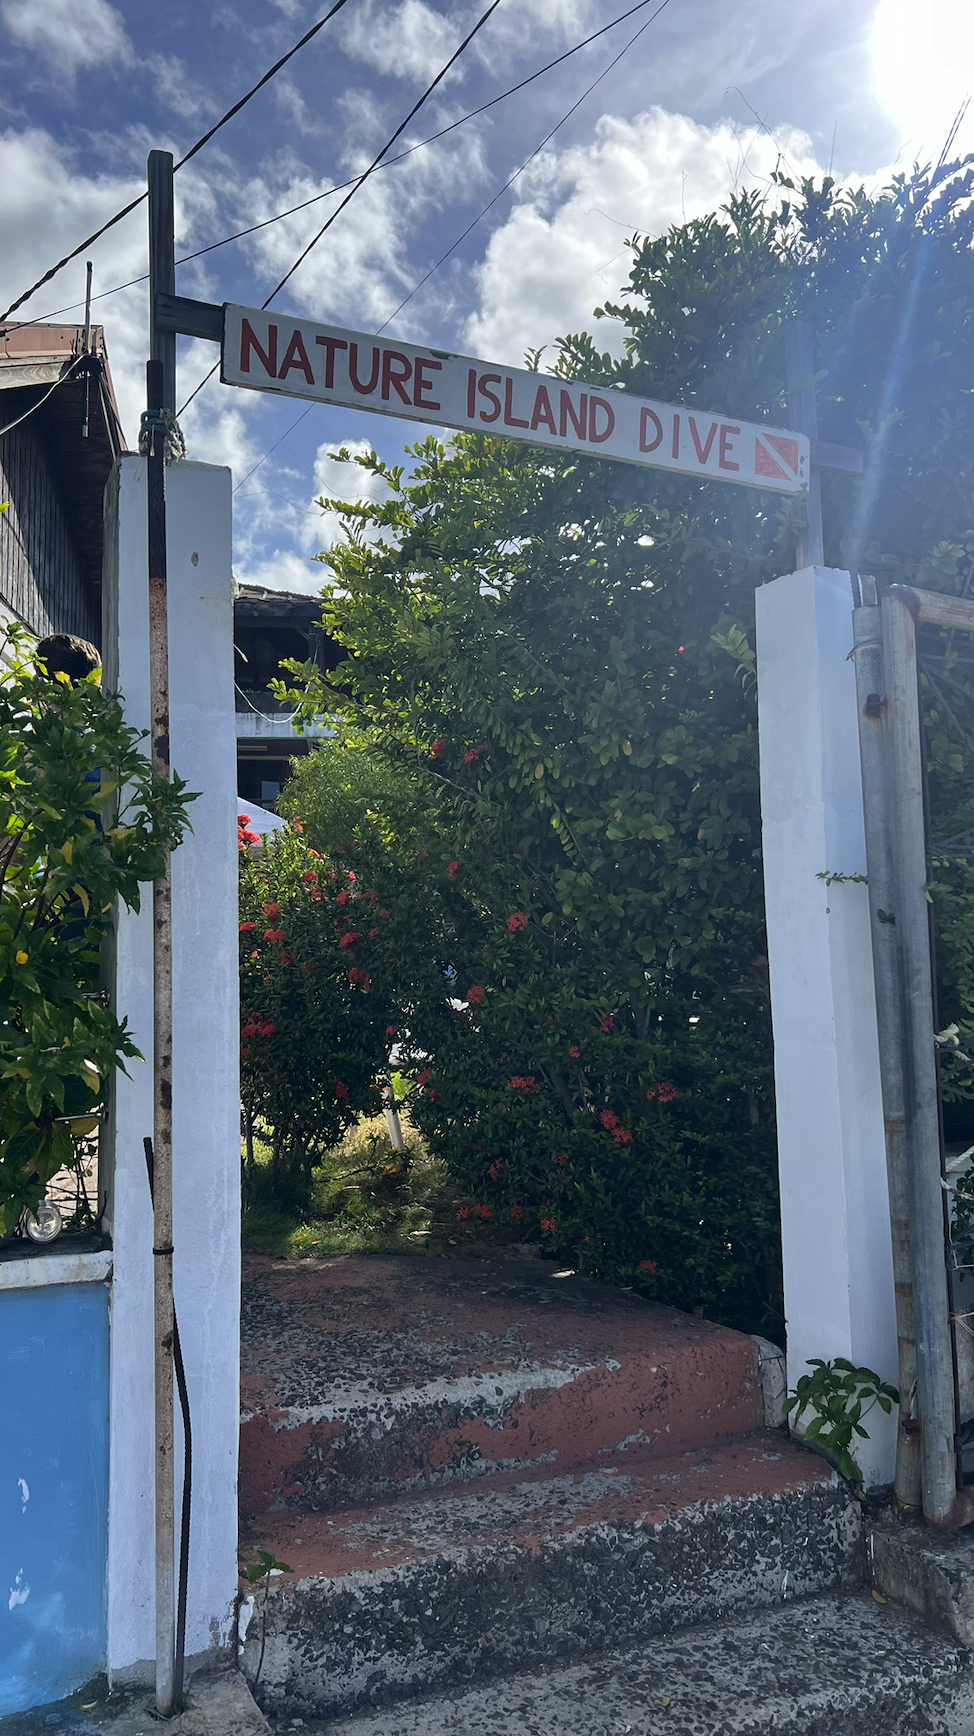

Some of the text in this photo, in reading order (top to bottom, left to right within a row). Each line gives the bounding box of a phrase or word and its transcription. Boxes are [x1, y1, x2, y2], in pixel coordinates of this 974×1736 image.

[239, 318, 741, 471] NATURE ISLAND DIVE
